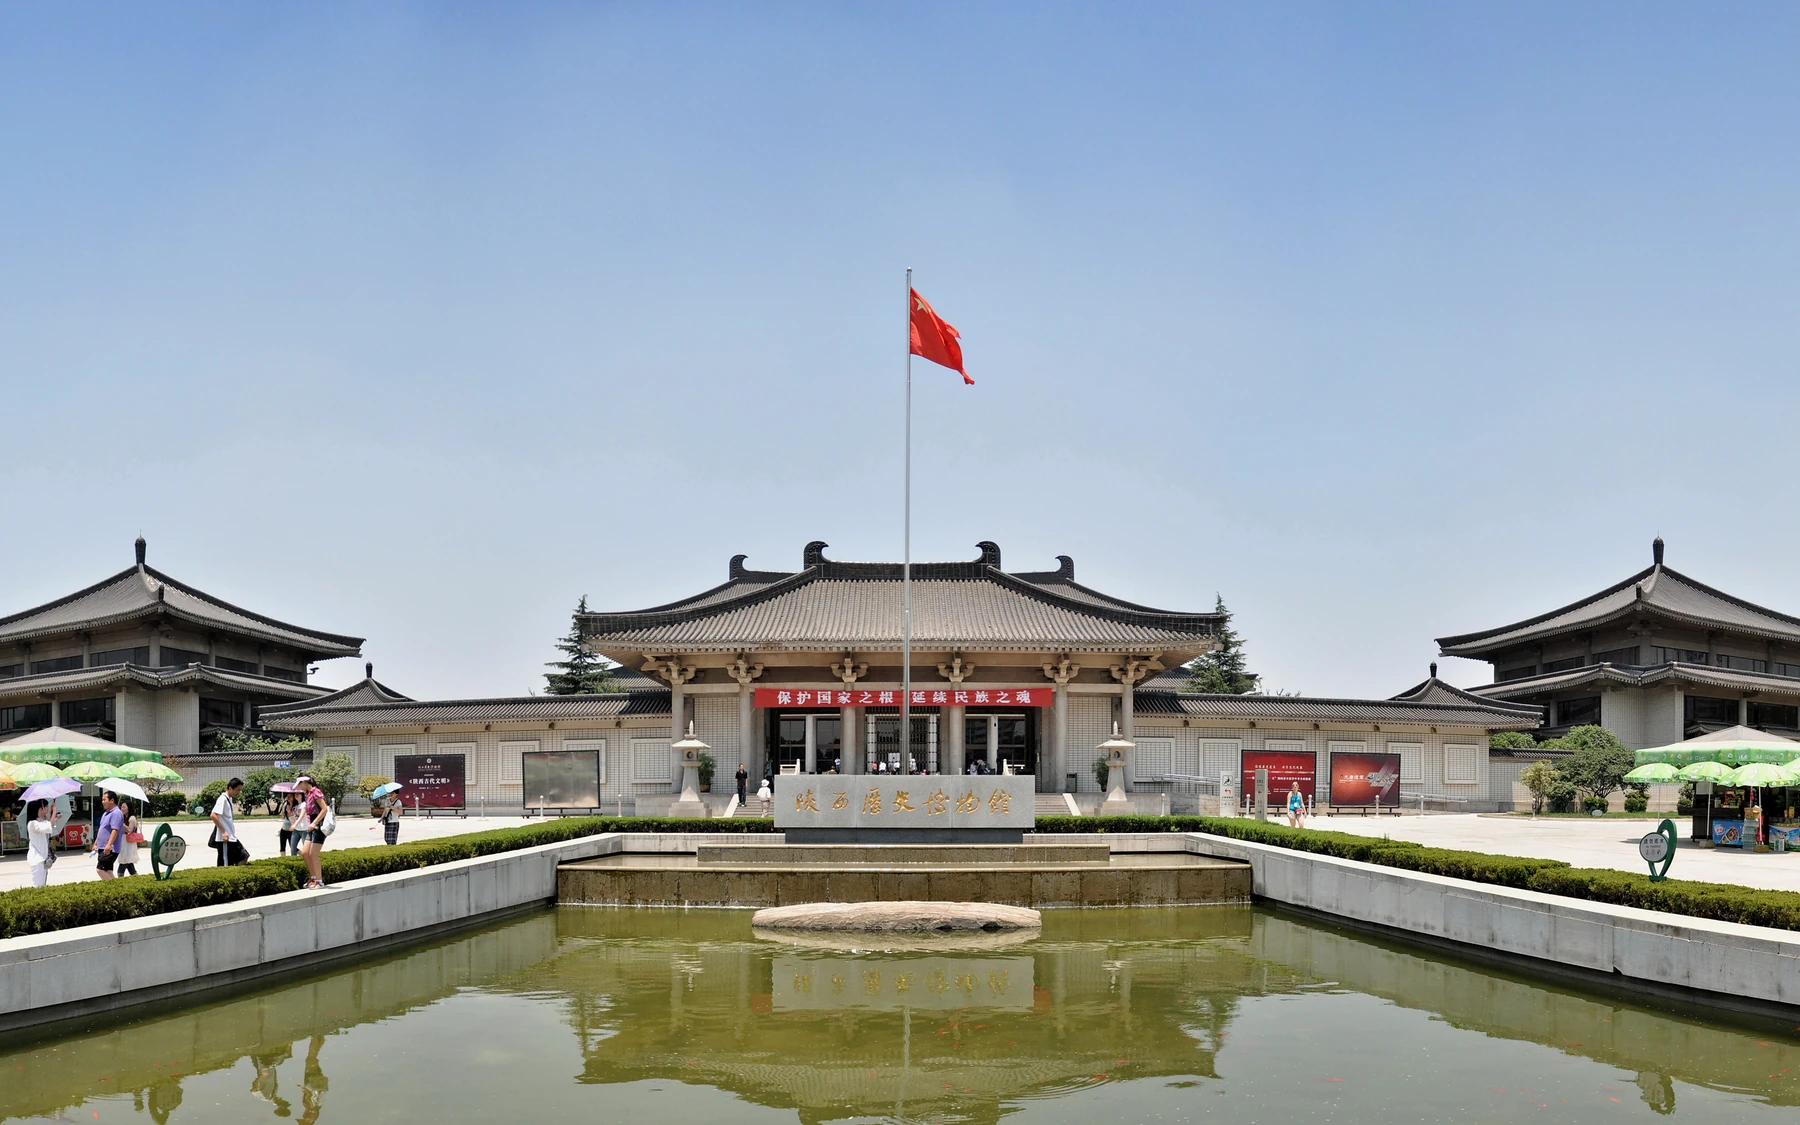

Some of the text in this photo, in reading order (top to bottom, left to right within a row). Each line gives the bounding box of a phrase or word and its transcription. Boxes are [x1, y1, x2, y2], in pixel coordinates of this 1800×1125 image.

[777, 690, 1031, 704] 保护国家之根 延续民族之魂
